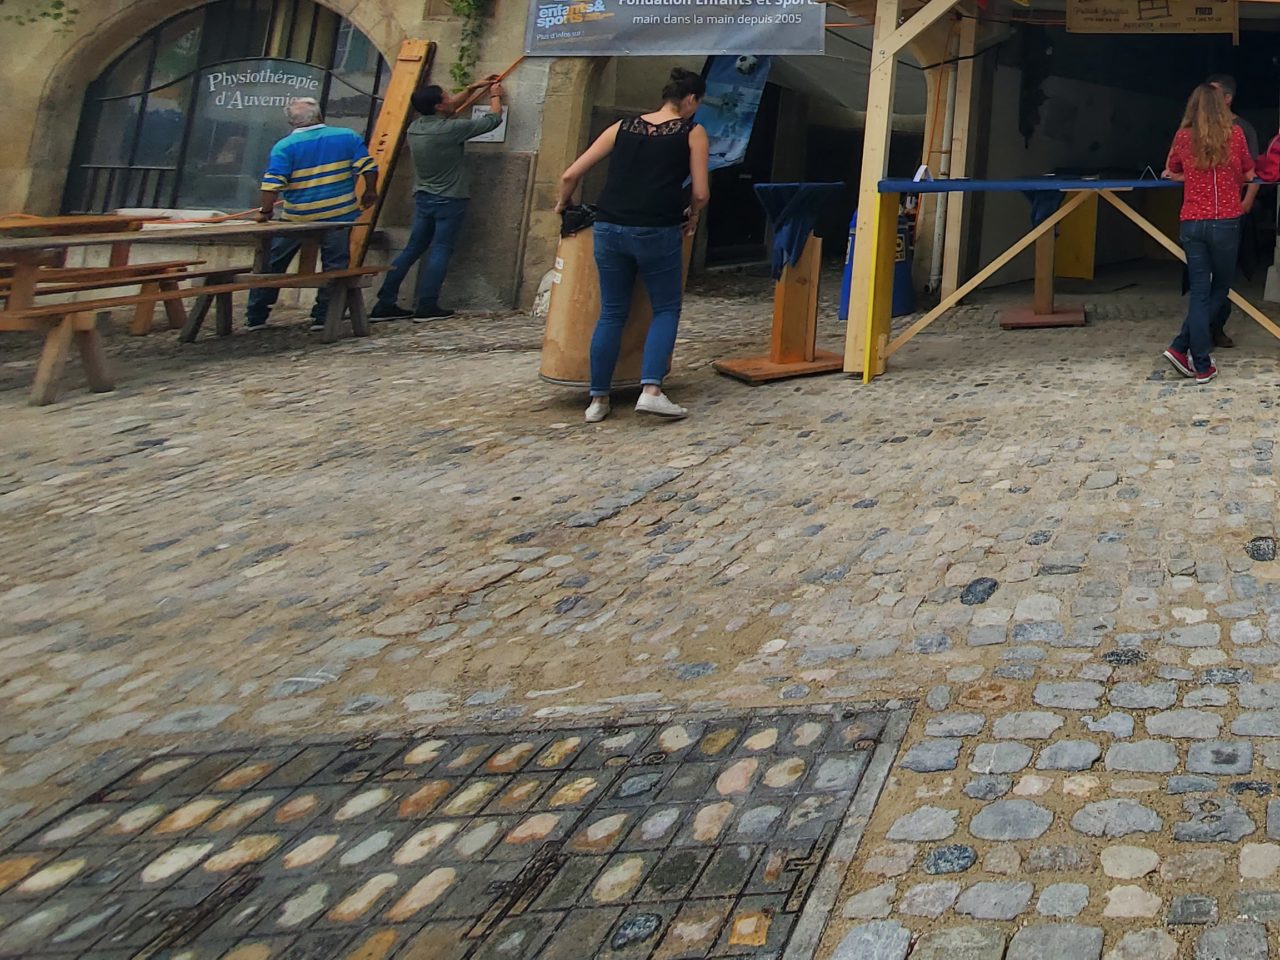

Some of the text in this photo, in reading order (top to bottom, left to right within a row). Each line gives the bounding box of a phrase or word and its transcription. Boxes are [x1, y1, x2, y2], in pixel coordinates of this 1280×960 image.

[537, 13, 583, 28] sports
[633, 13, 802, 27] main dans la main depuis 2005
[207, 68, 319, 92] Physiothérapie
